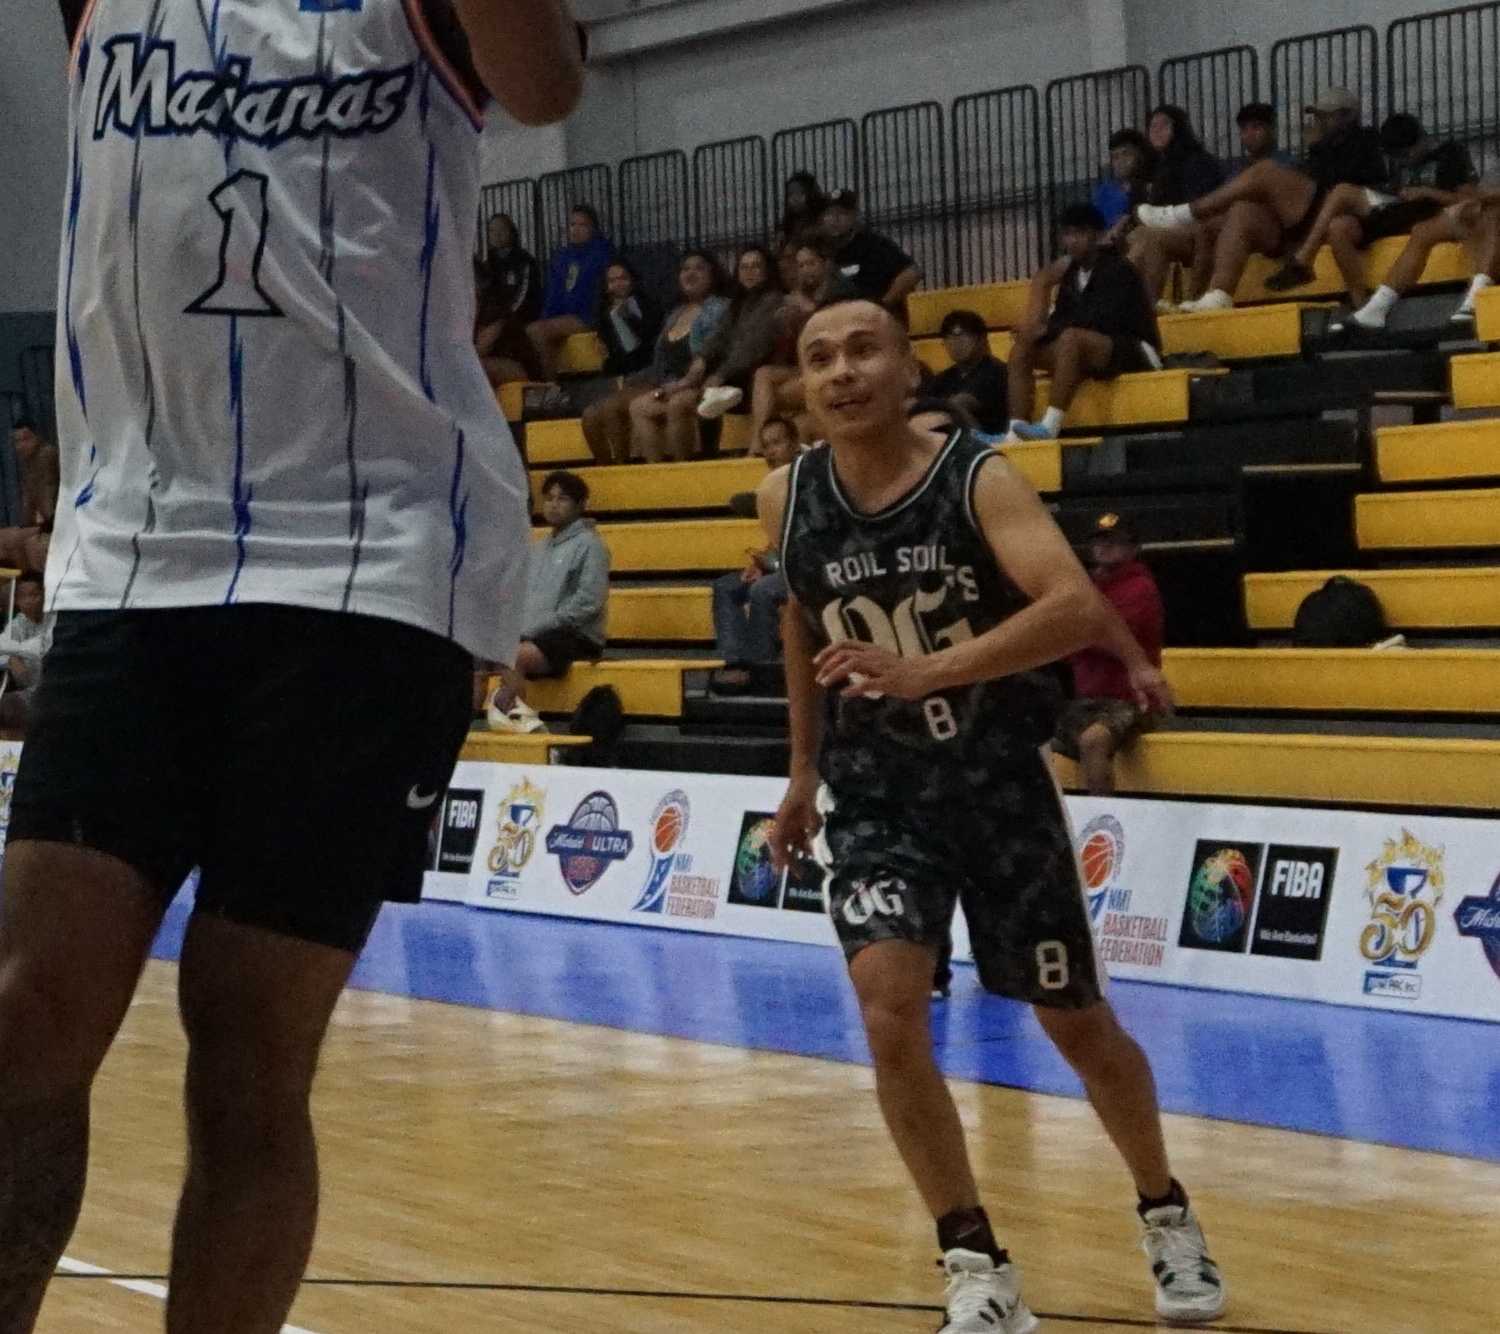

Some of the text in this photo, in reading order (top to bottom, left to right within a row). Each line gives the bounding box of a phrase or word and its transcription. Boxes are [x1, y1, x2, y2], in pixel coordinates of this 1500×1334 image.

[183, 169, 285, 317] 1
[825, 544, 956, 589] ROIL SOIL
[923, 697, 958, 741] 8
[448, 799, 478, 830] FIBA
[590, 837, 629, 854] ULTRA
[1271, 859, 1324, 900] FIBA
[1102, 912, 1170, 942] BASKETBALL
[1358, 891, 1437, 960] 50
[1036, 939, 1069, 990] 8
